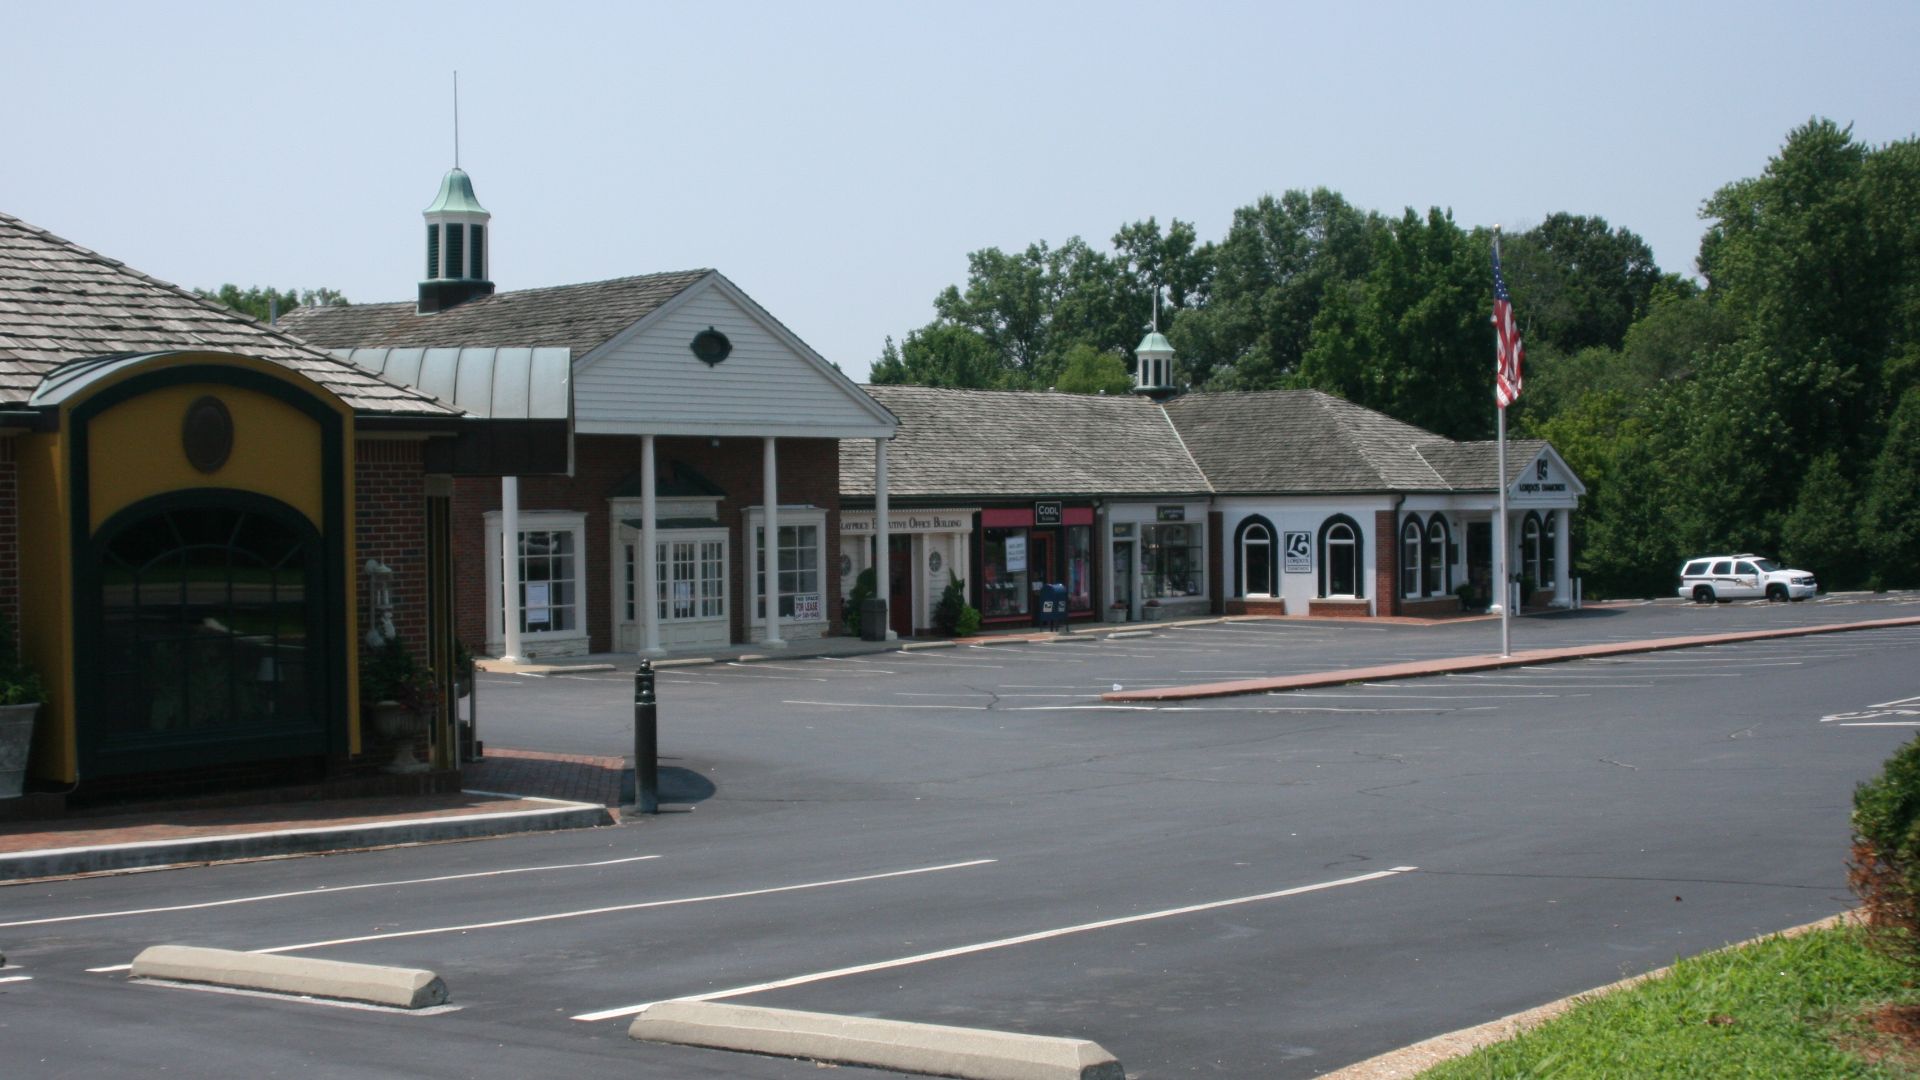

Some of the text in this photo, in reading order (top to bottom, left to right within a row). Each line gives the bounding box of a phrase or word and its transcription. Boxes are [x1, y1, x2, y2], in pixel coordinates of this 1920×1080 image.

[1038, 505, 1059, 515] COOL
[909, 516, 931, 529] OFFICE
[933, 516, 962, 528] BUILDING
[804, 601, 819, 611] LEASE
